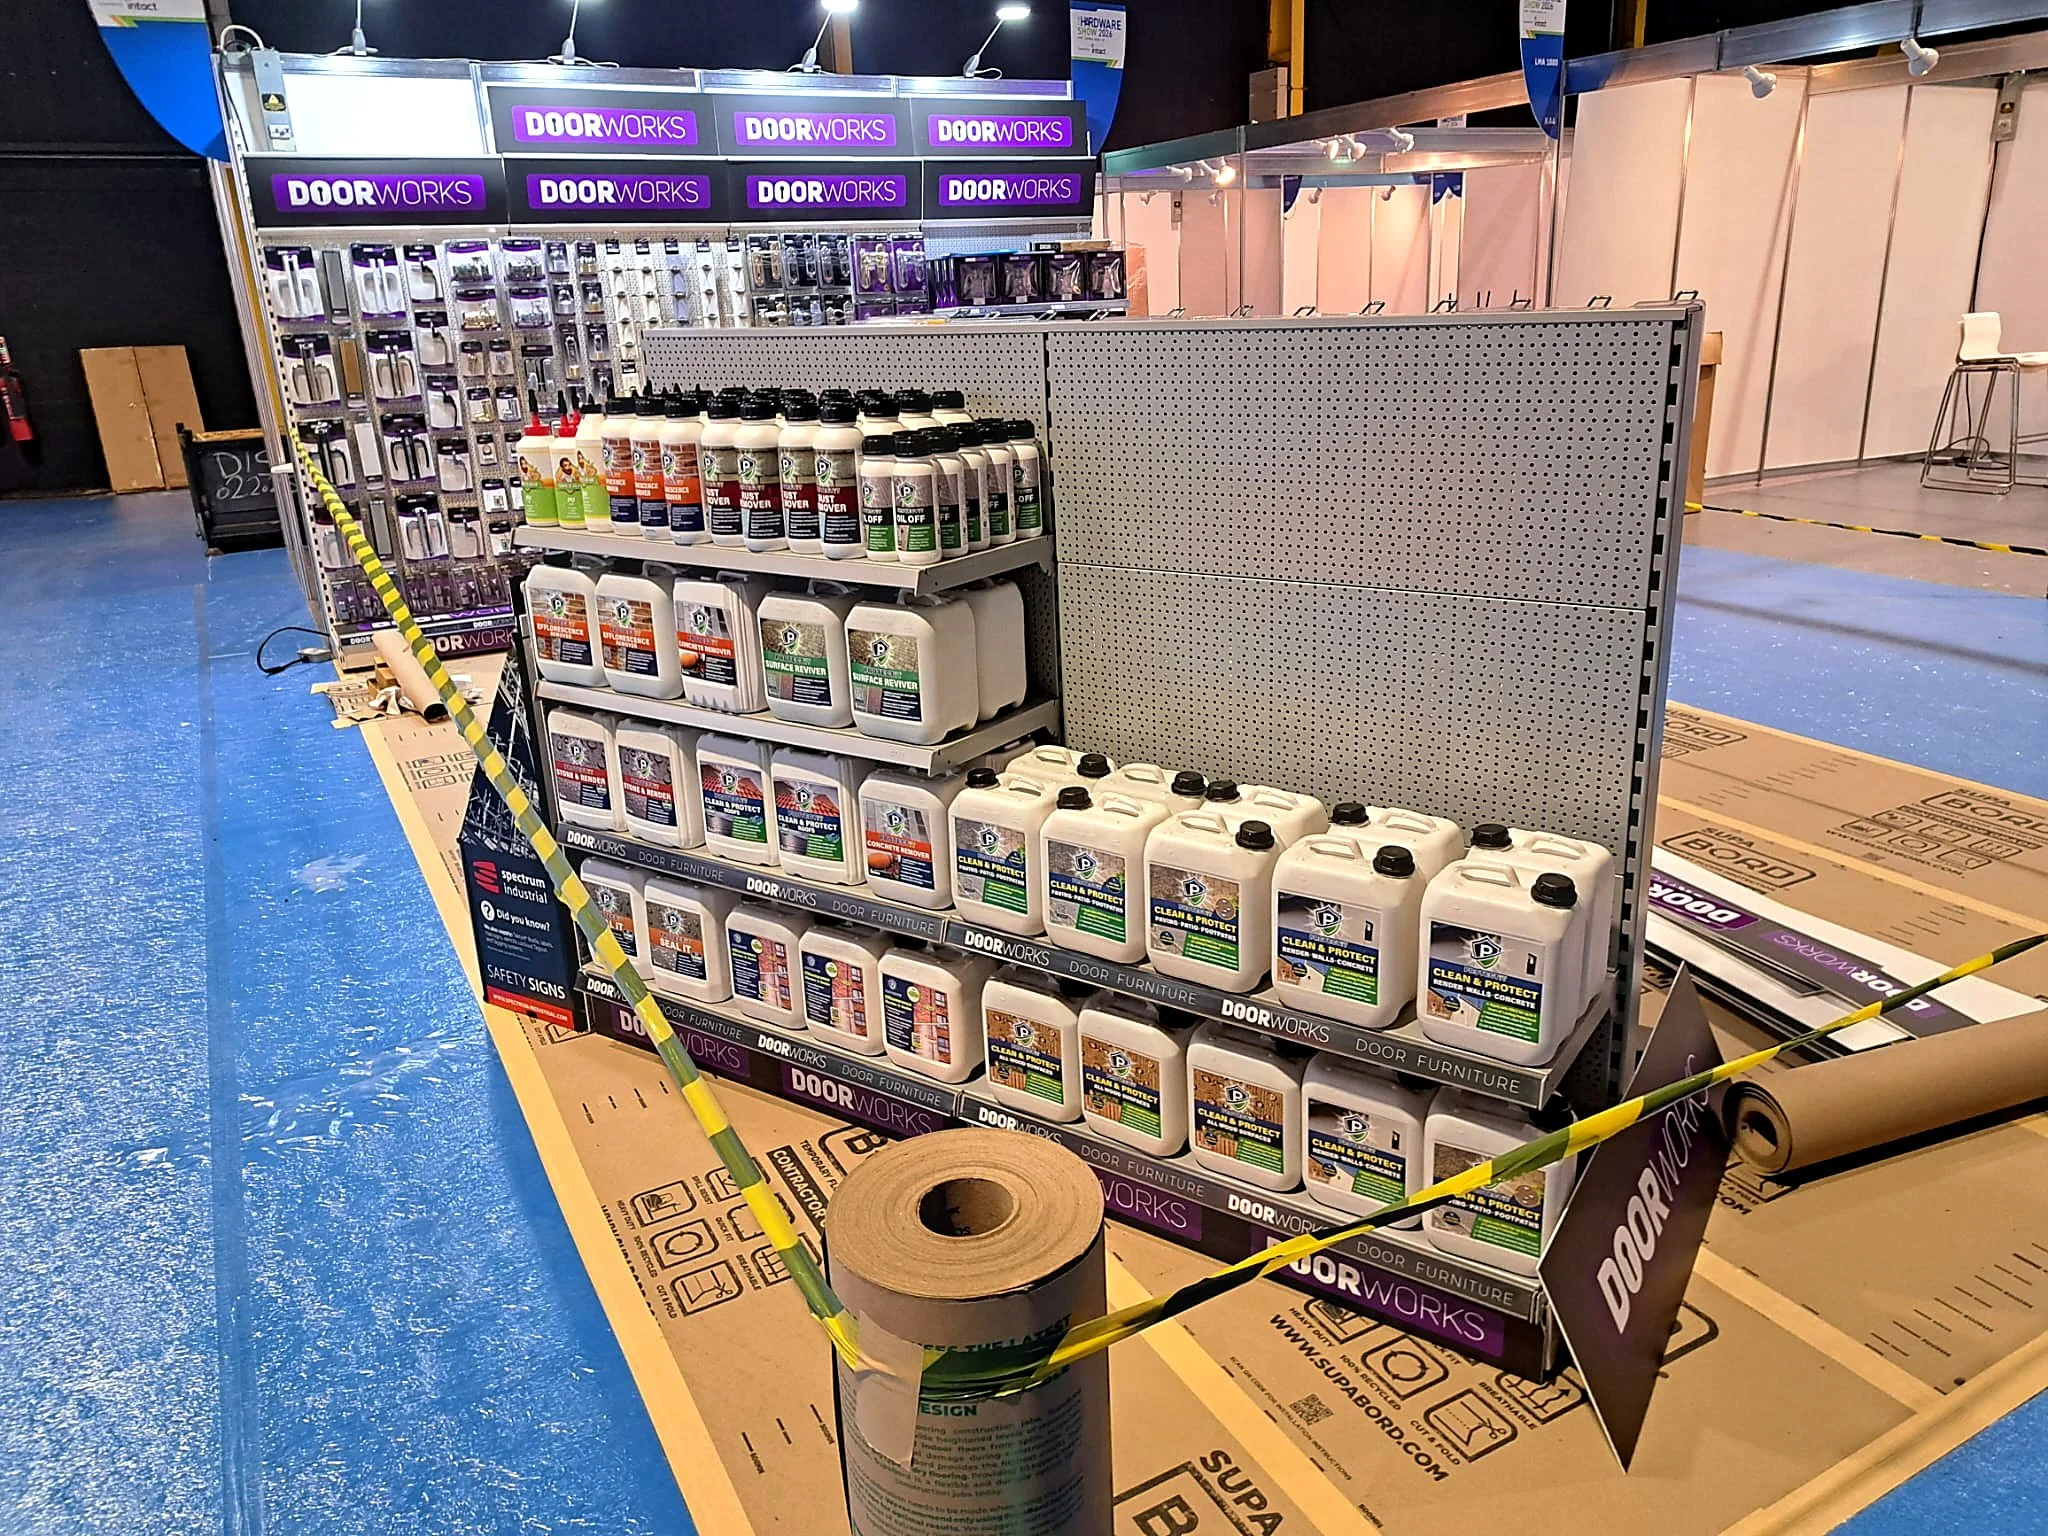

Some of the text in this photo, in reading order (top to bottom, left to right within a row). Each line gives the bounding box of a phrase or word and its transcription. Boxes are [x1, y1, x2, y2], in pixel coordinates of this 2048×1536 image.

[127, 2, 158, 11] intact
[1080, 16, 1122, 31] HARDWARE
[524, 110, 687, 139] DOORWORKS
[744, 116, 888, 142] DOORWORKS
[937, 119, 1064, 144] DOORWORKS
[288, 179, 472, 207] DOORWORKS
[539, 178, 700, 206] DOORWORKS
[757, 179, 897, 204] DOORWORKS
[948, 177, 1072, 201] DOORWORKS
[868, 515, 883, 523] OFF
[537, 624, 584, 636] EFFLORESCENCE
[603, 631, 649, 645] EFFLORESCENCE
[679, 640, 731, 655] CONCRETE REMOVER
[765, 660, 827, 676] SURFACE REVIVER
[853, 672, 917, 690] SURFACE REVIVER
[705, 797, 761, 813] CLEAN PROTECT
[778, 815, 837, 831] CLEAN PROTECT
[867, 840, 930, 859] CONCRETE REMOVER
[1702, 827, 1754, 848] SUPA
[567, 830, 724, 880] DOORWORKS DOOR FURNITURE
[958, 855, 1025, 878] CLEAN & PROTECT
[1682, 839, 1795, 879] BORD
[501, 870, 545, 888] spectrum
[1051, 880, 1123, 905] CLEAN & PROTECT
[504, 883, 547, 904] industrial
[746, 877, 935, 934] DOORWORKS DOOR FURNITURE
[497, 909, 550, 931] Did you know?
[1154, 906, 1237, 933] CLEAN & PROTECT
[1155, 916, 1237, 942] PAVING PATIO FOOTPATHS
[660, 939, 691, 953] SEAL IT
[1282, 936, 1376, 965] CLEAN & PROTECT
[1282, 946, 1373, 973] RENDER WALLS CONCRETE
[965, 931, 1196, 1001] DOORWORKS DOOR FURNITURE
[487, 964, 526, 988] SAFETY
[528, 977, 565, 999] SIGNS
[1433, 968, 1539, 999] CLEAN & PROTECT
[1433, 979, 1535, 1009] RENDER WALLS CONCRETE
[690, 1014, 742, 1040] FURNITURE
[991, 1044, 1060, 1071] CLEAN & PROTECT
[1220, 999, 1521, 1095] DOORWORKS DOOR FURNITURE
[758, 1034, 827, 1069] DOORWORKS
[842, 1065, 872, 1085] DOOR
[879, 1077, 941, 1106] FURNITURE
[791, 1068, 932, 1135] DOORWORKS
[1086, 1073, 1158, 1103] CLEAN & PROTECT
[1198, 1108, 1281, 1138] CLEAN & PROTECT
[800, 1140, 832, 1177] TEMPORARY
[979, 1107, 1204, 1197] DOORWORKS DOOR FURNITURE
[1312, 1138, 1403, 1170] CLEAN & PROTECT
[1480, 1196, 1488, 1205] &
[1488, 1198, 1540, 1221] PROTECT
[1494, 1211, 1540, 1228] FOOTPATHS
[1356, 1241, 1405, 1267] DOOR
[1416, 1261, 1514, 1307] FURNITURE
[1289, 1307, 1335, 1348] HEAVY DUTY
[1340, 1354, 1401, 1411] 100% RECYCLED
[919, 1404, 977, 1416] ESIGN
[1269, 1314, 1450, 1482] WWW.SUPABORD.COM
[1479, 1381, 1537, 1430] BREATHABLE
[1410, 1420, 1460, 1466] CUT FOLD
[1199, 1450, 1284, 1536] SUPA
